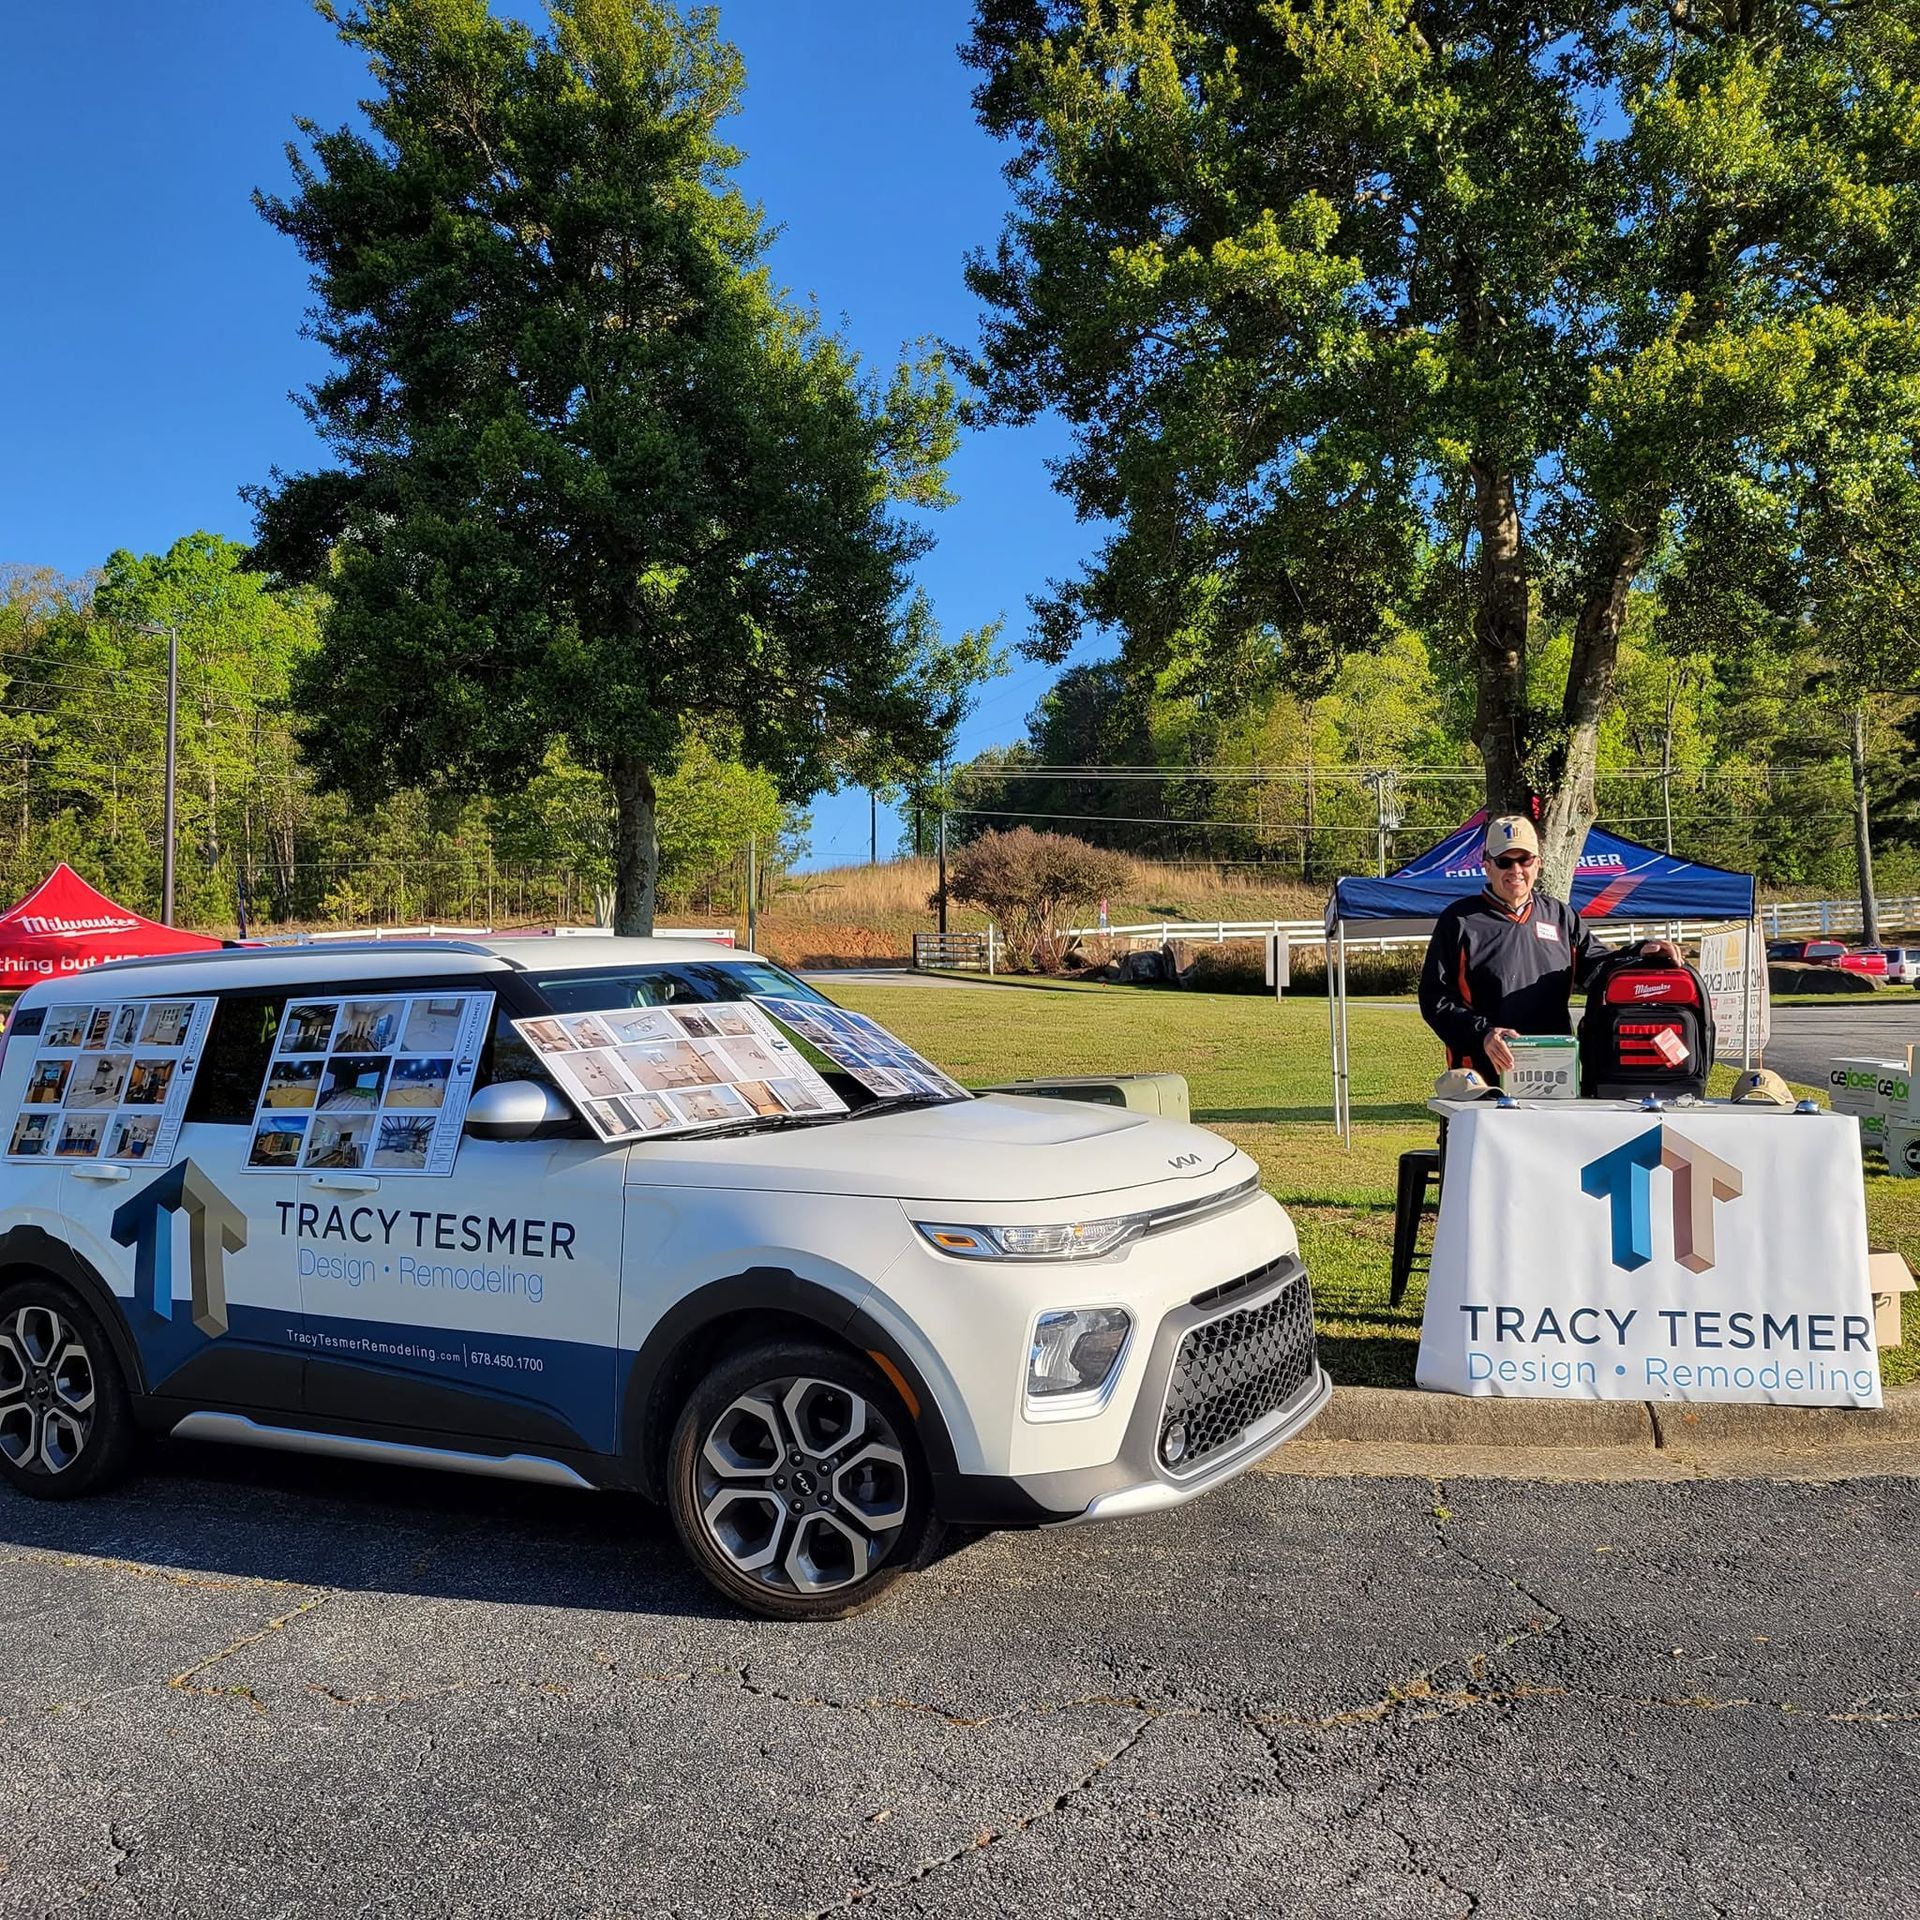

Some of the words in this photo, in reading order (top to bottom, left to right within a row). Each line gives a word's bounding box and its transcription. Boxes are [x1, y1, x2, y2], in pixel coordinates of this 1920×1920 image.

[1445, 867, 1487, 878] COLL
[1576, 853, 1623, 868] REER
[12, 915, 141, 935] Milwaukee
[61, 956, 97, 970] but
[1633, 983, 1671, 997] Milwaukee
[1878, 1076, 1909, 1102] cejo
[275, 1200, 401, 1244] TRACY
[409, 1210, 576, 1260] TESMER
[300, 1248, 376, 1287] Design
[399, 1256, 544, 1303] Remodeling
[1459, 1305, 1638, 1346] TRACY
[1658, 1310, 1872, 1352] TESMER
[286, 1328, 460, 1362] TracyTesmerRemodeling.com
[470, 1350, 543, 1372] 678.450.1700
[1468, 1352, 1596, 1389] Design
[1645, 1357, 1873, 1397] Remodeling
